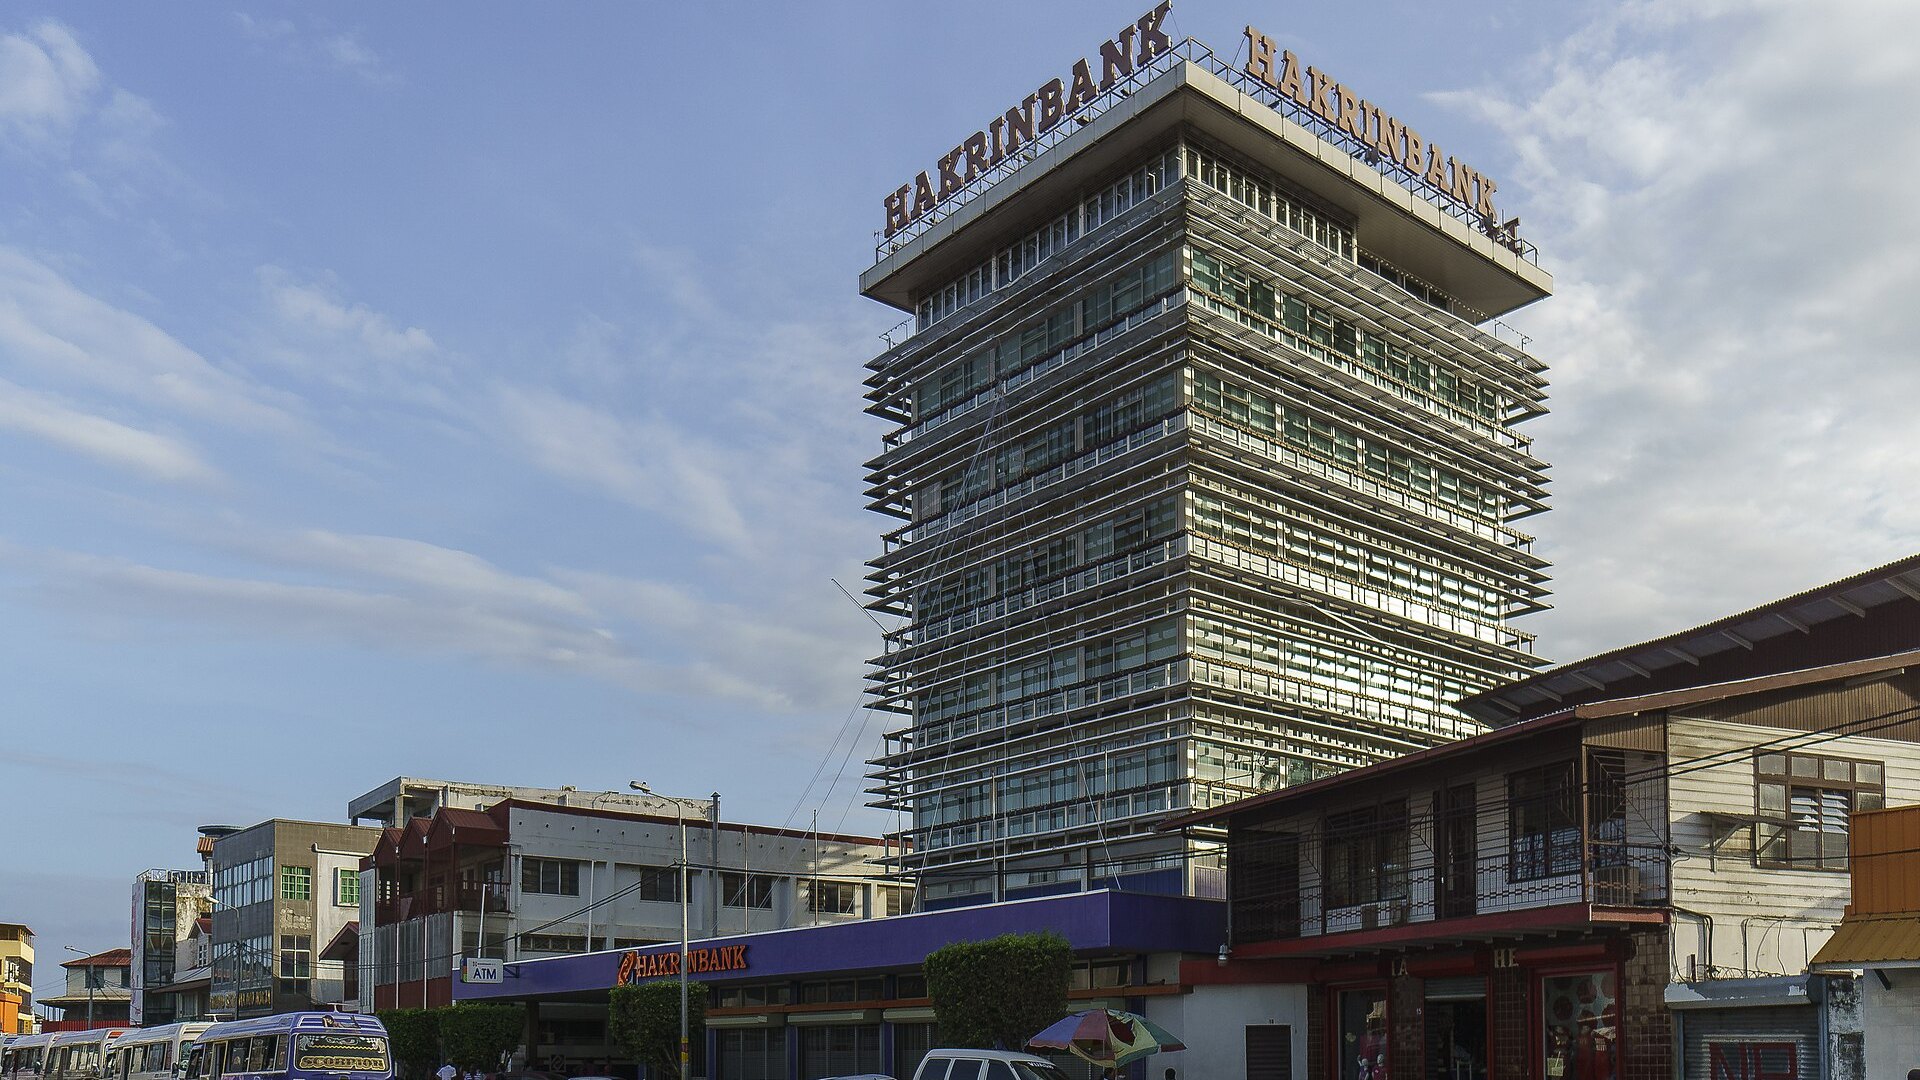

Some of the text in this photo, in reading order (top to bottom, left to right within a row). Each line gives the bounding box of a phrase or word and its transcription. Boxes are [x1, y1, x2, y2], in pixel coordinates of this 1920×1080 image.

[883, 0, 1174, 239] HAKRINBANK
[1245, 24, 1498, 222] HAKRINBANK
[473, 968, 497, 979] ATM
[637, 944, 748, 978] HAKRNBANK
[300, 1056, 386, 1071] SCORPION
